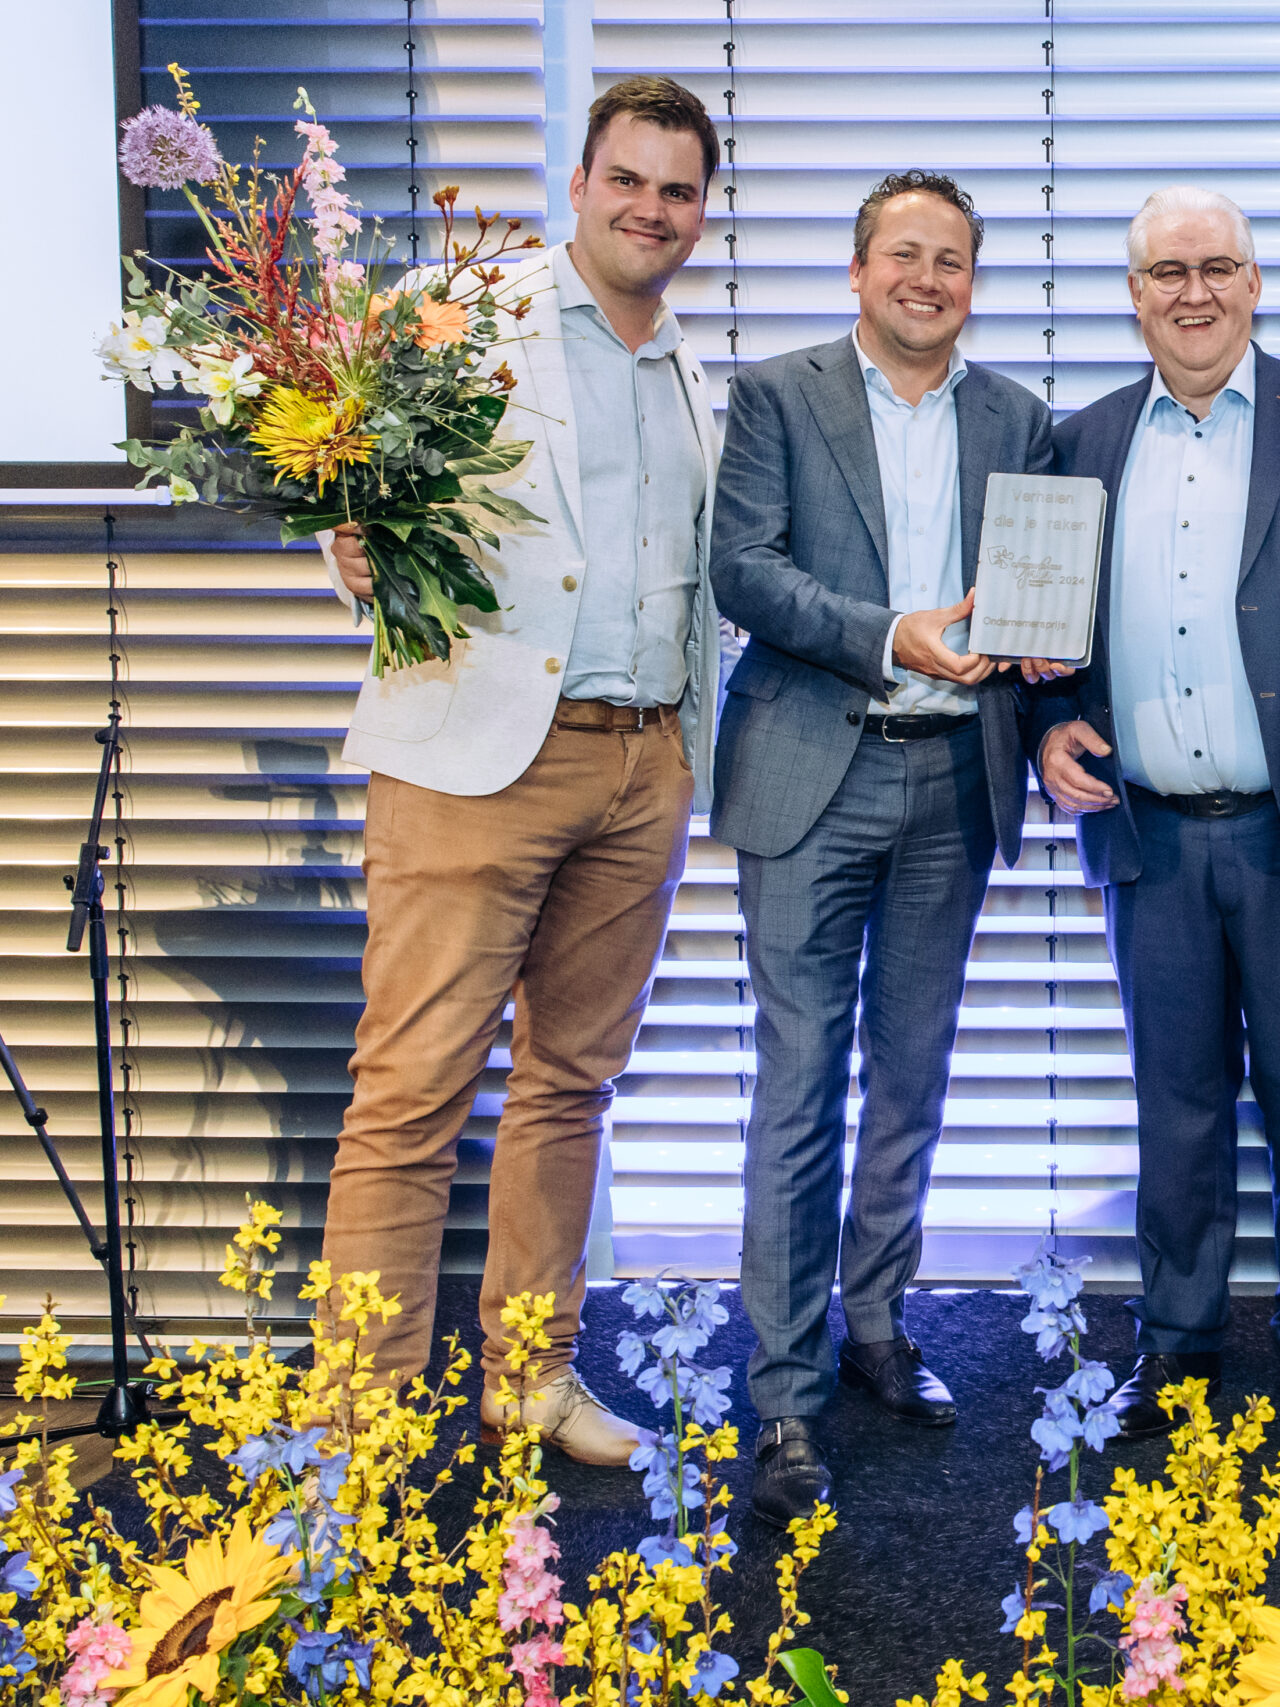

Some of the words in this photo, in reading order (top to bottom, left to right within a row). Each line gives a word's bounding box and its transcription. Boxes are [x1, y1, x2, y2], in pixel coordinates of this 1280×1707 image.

[994, 514, 1014, 528] die
[1024, 516, 1036, 532] je
[1047, 517, 1088, 532] raken
[1059, 575, 1085, 585] 2024
[983, 616, 1068, 632] Ondernemersprijs
